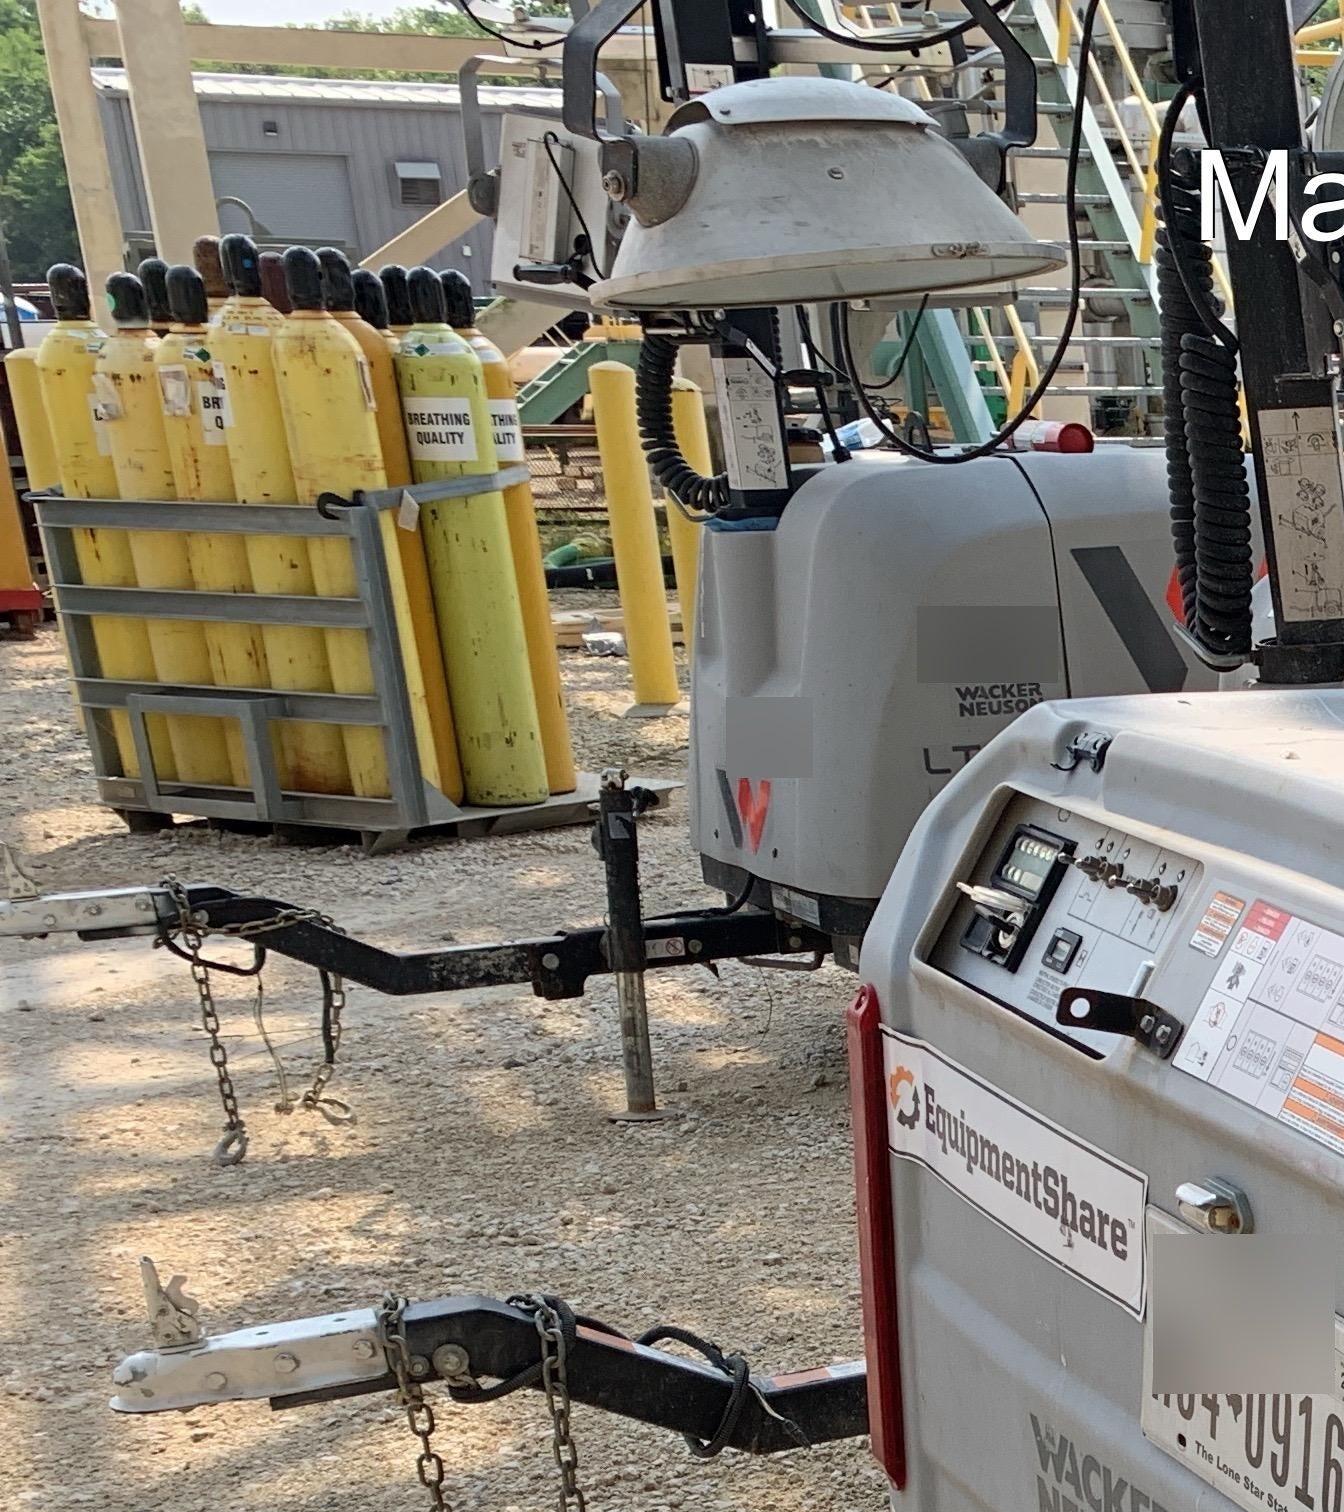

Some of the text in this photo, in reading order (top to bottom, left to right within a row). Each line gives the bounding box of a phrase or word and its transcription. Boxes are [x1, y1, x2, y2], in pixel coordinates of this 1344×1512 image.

[407, 412, 471, 426] BREATHING
[416, 431, 465, 446] QUALITY
[955, 682, 1043, 701] WACKER
[1195, 1440, 1214, 1465] The
[1216, 1455, 1241, 1485] Lone
[1243, 1474, 1265, 1502] Star
